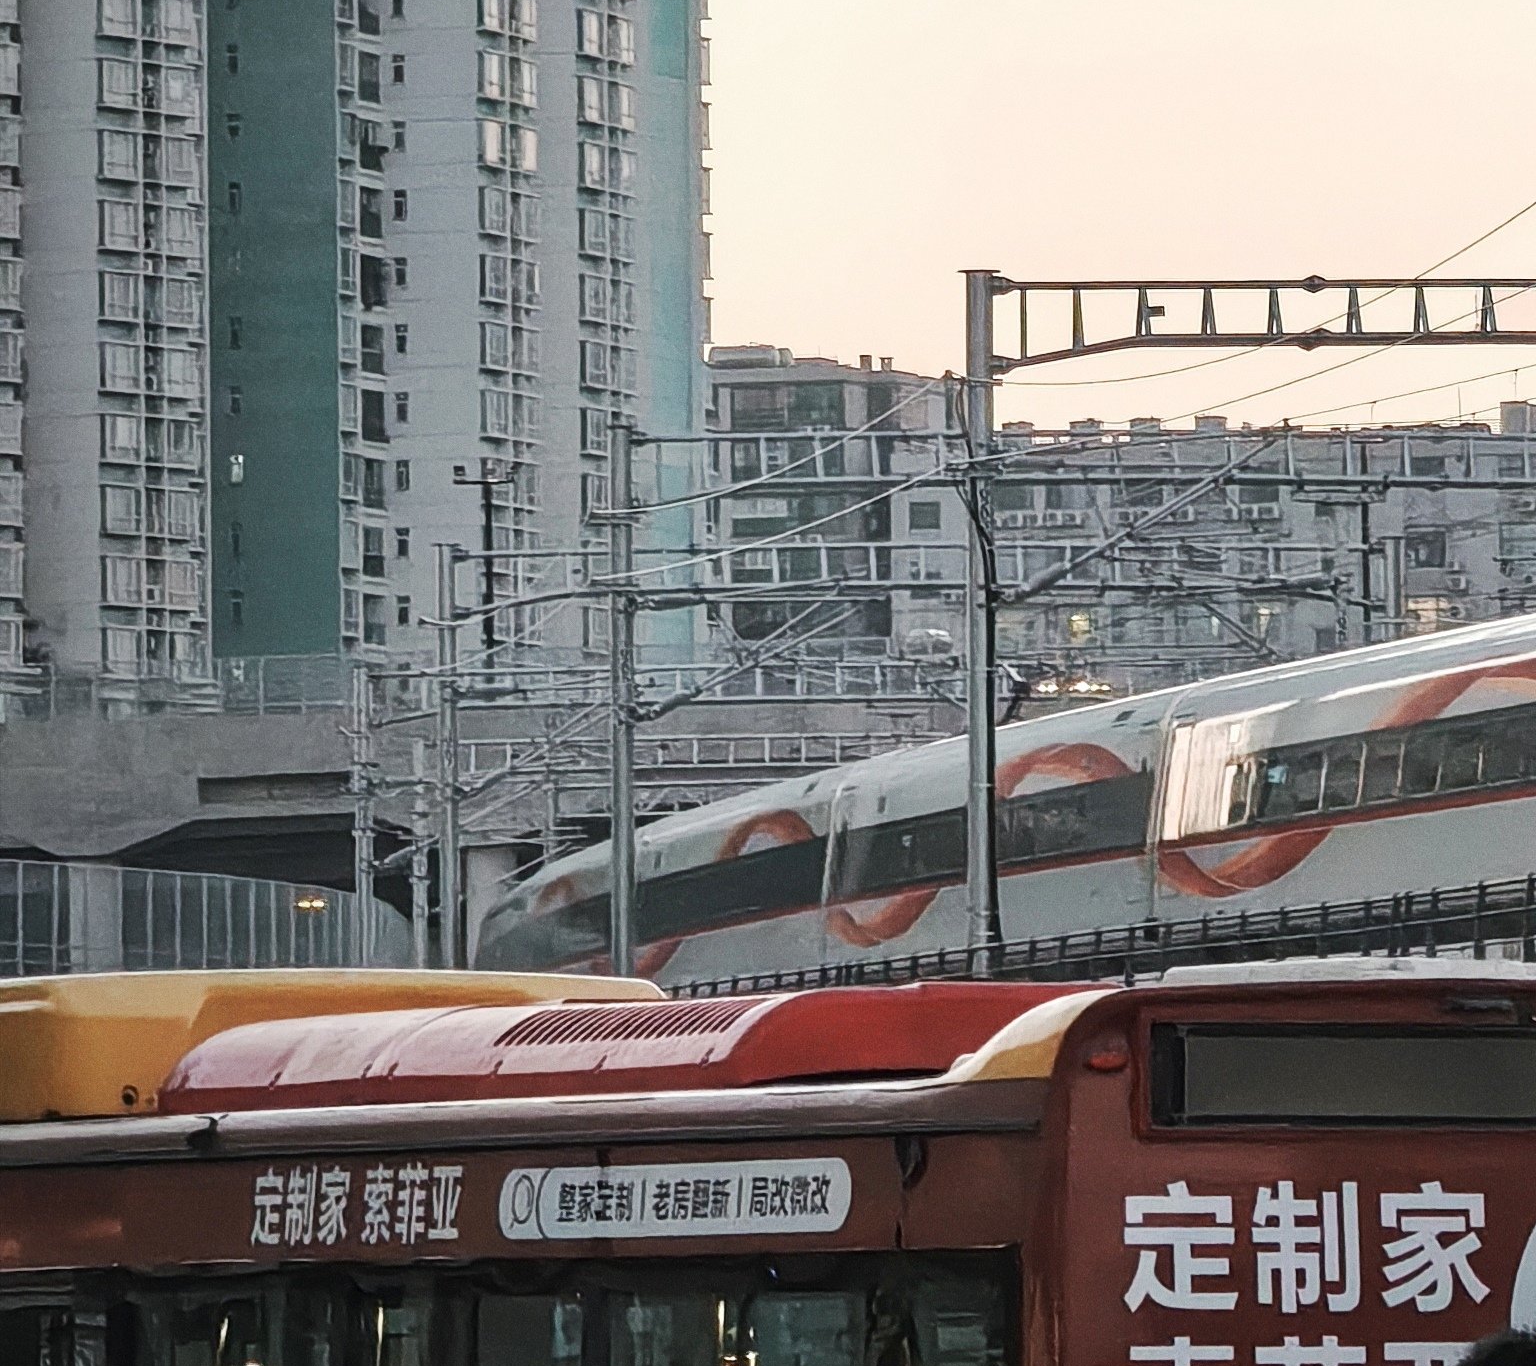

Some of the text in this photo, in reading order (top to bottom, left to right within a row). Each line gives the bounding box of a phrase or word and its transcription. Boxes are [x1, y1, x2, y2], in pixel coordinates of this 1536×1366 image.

[251, 1161, 463, 1247] 定制家 索菲亚
[1123, 1180, 1491, 1314] 定制家
